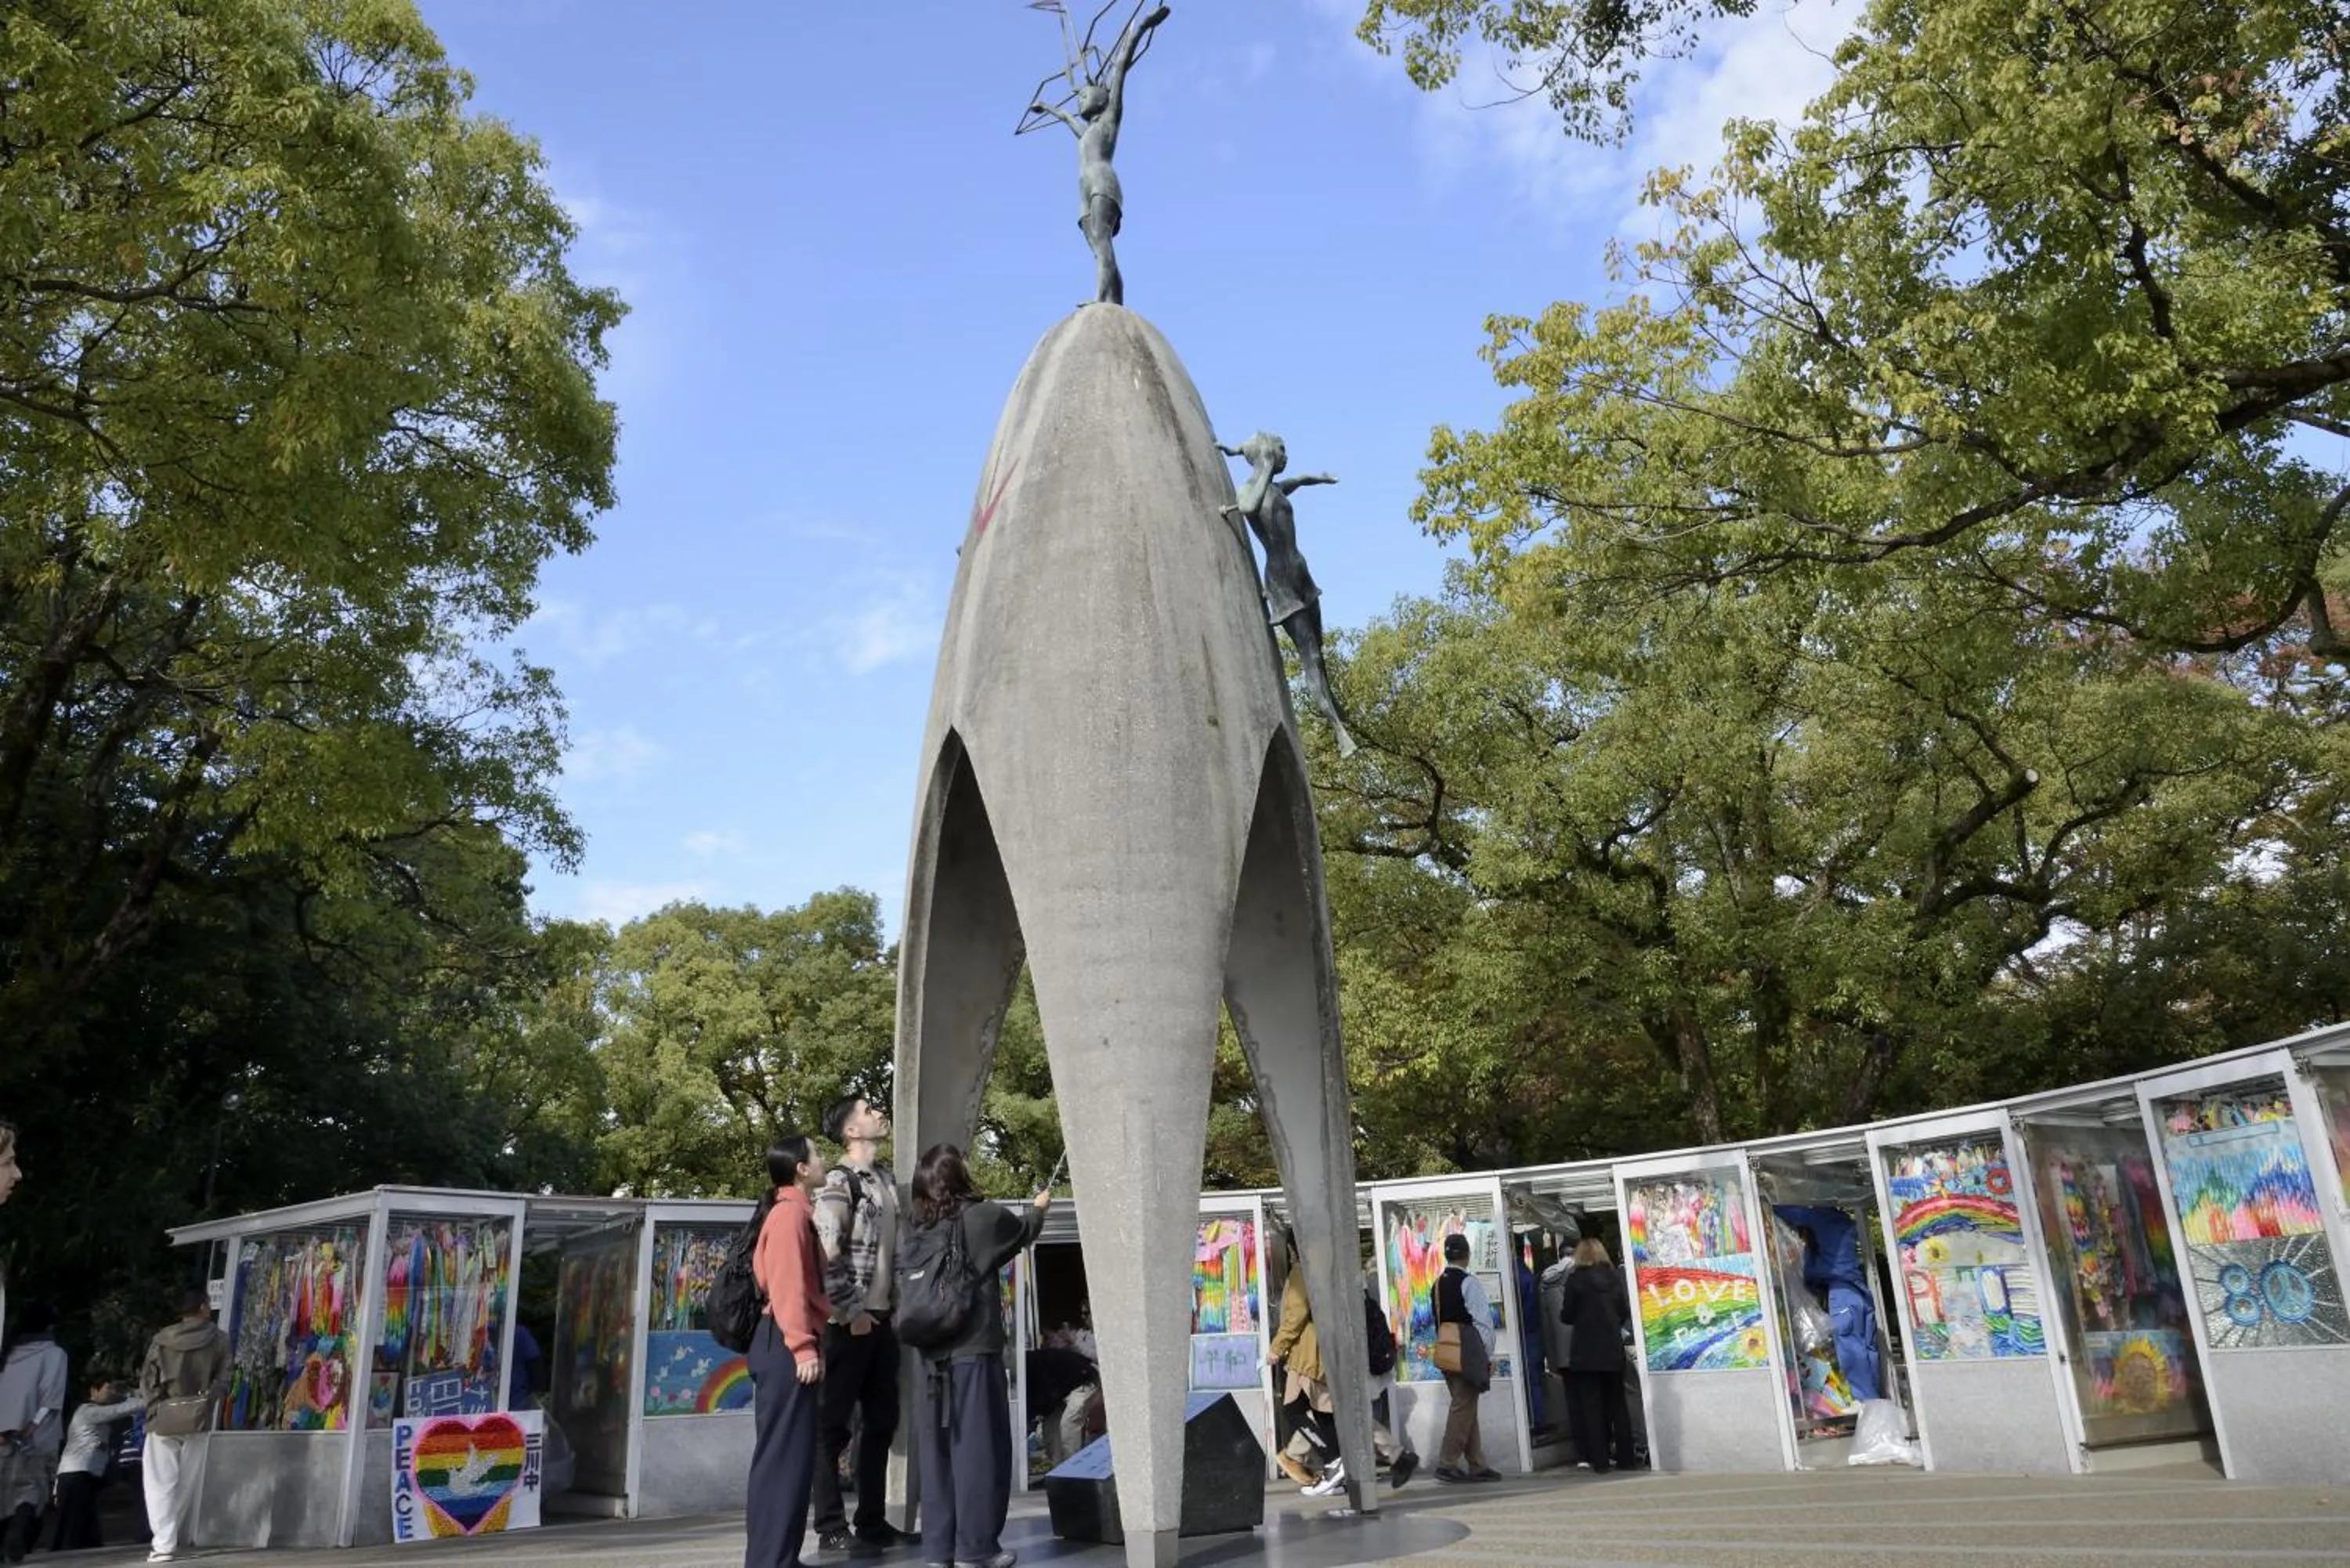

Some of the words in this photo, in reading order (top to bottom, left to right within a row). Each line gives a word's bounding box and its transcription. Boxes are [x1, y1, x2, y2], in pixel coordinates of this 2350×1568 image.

[1648, 1278, 1747, 1307] LOVE
[1695, 1302, 1716, 1324] &
[396, 1425, 414, 1540] PEACE
[524, 1433, 542, 1492] 三川中
